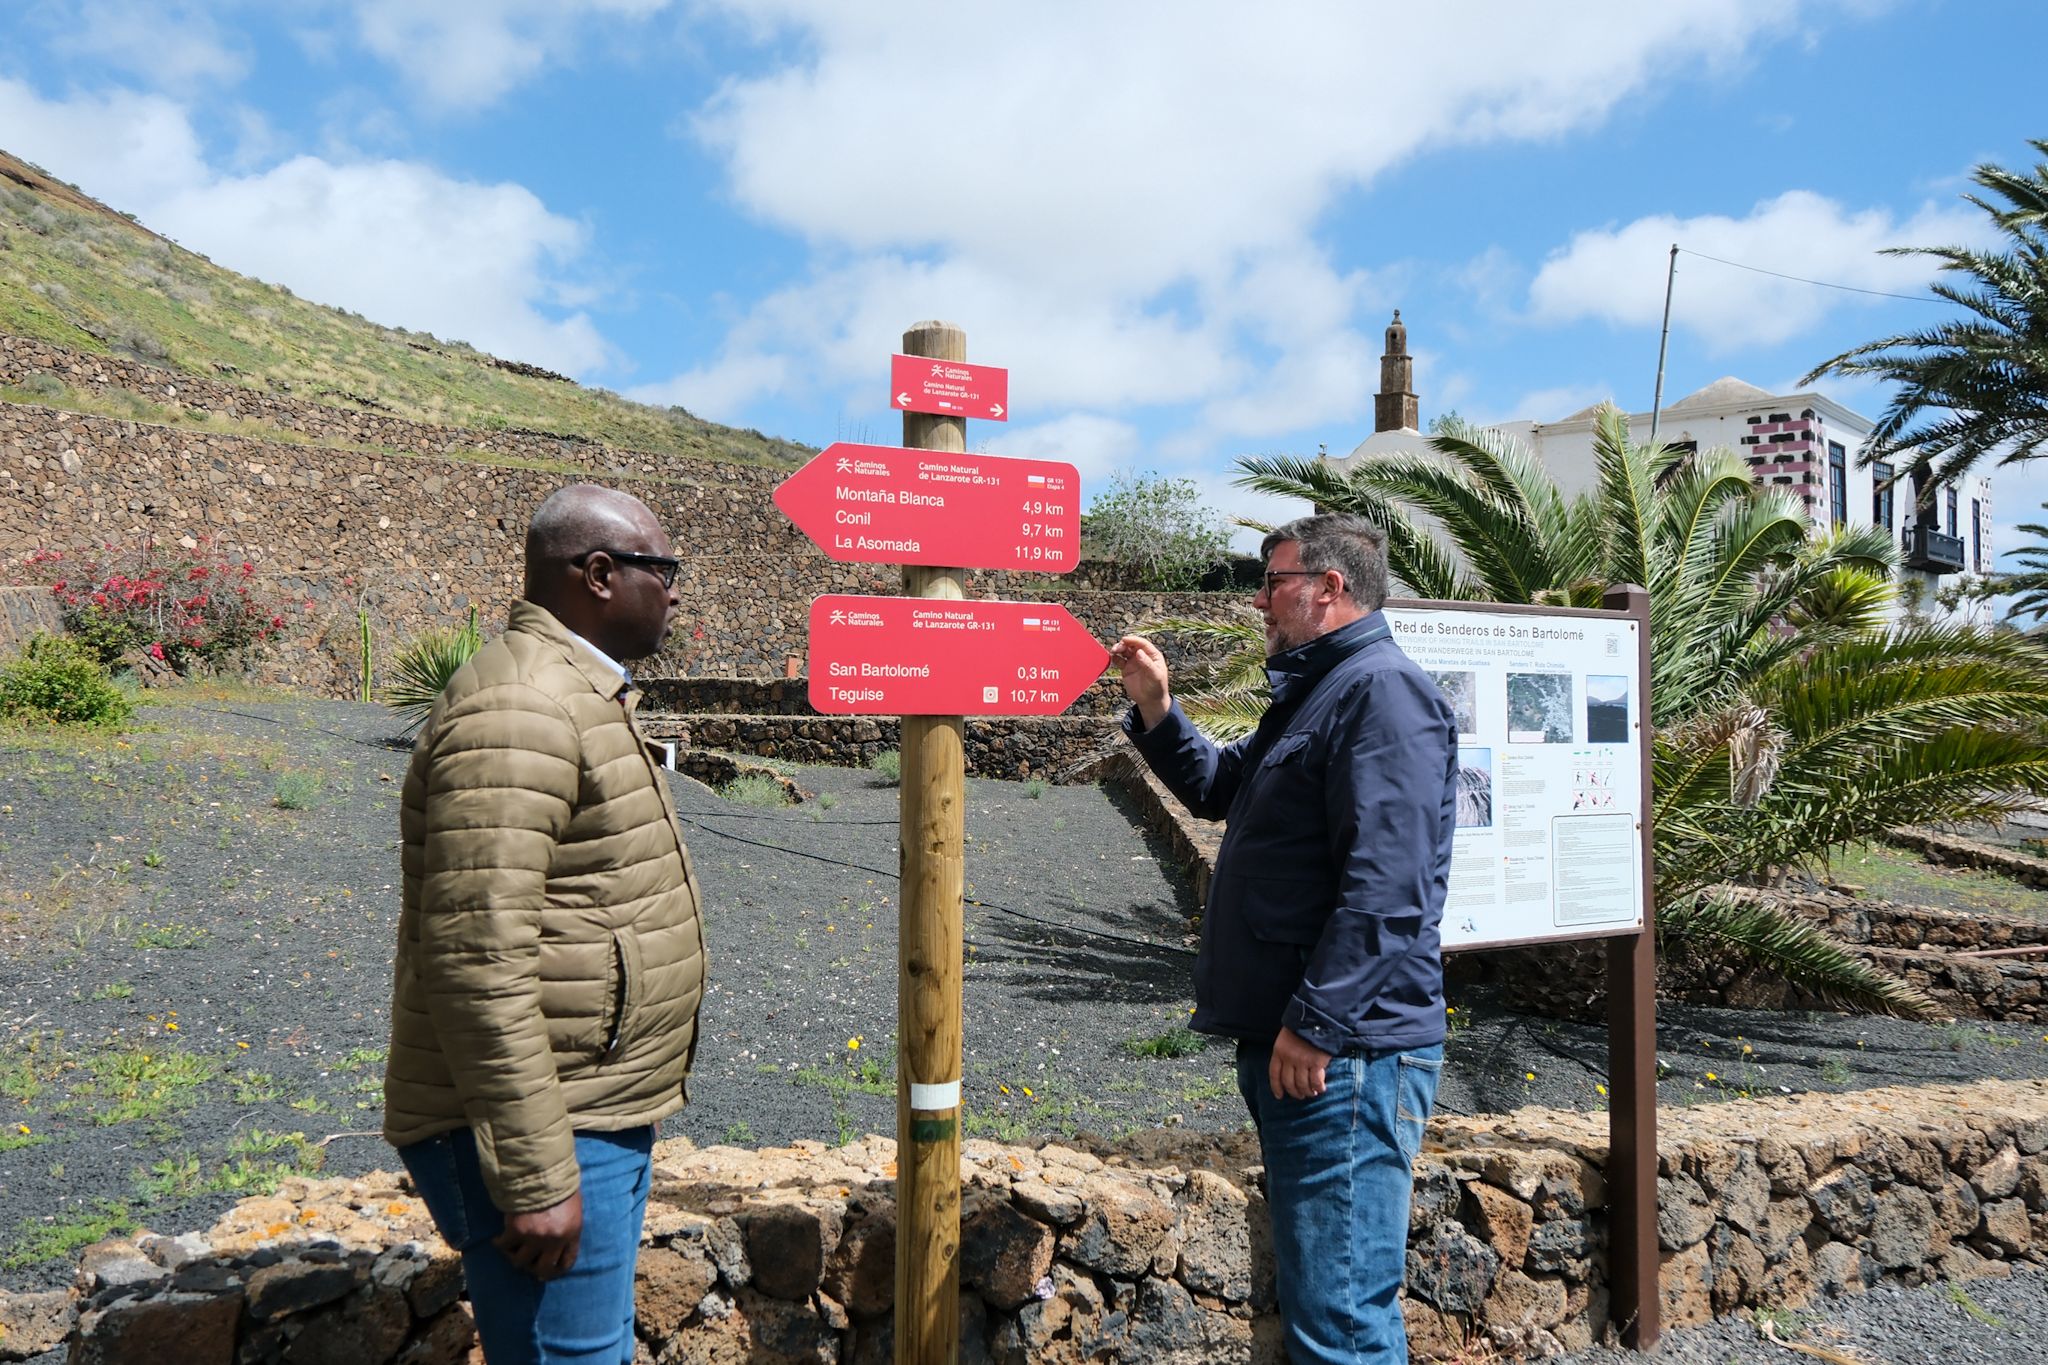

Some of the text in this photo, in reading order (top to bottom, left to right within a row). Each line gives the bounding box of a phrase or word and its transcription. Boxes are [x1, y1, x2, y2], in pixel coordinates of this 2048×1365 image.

[945, 367, 969, 376] Caminos
[945, 373, 972, 381] Naturales
[924, 381, 965, 391] Camino Natural
[932, 388, 959, 397] Lanzarote
[960, 392, 980, 400] GR-131
[855, 460, 886, 470] Caminos
[919, 462, 979, 474] Camino Natural
[855, 467, 890, 476] Naturales
[919, 472, 1000, 486] de Lanzarote GR-131
[836, 486, 1064, 515] Montaña Blanca 4,9 km
[836, 510, 1063, 538] Conil 9,7 km
[836, 534, 1062, 560] La Asomada 11,9 km
[848, 611, 880, 620] Caminos
[913, 610, 974, 620] Camino Natural
[848, 619, 884, 627] Naturales
[913, 620, 995, 630] de Lanzarote GR-131
[1394, 621, 1584, 640] Red de Senderos de San Bartolomé
[829, 662, 1059, 681] San Bartolomé 0,3 km
[829, 687, 1059, 704] Teguise 10,7 km
